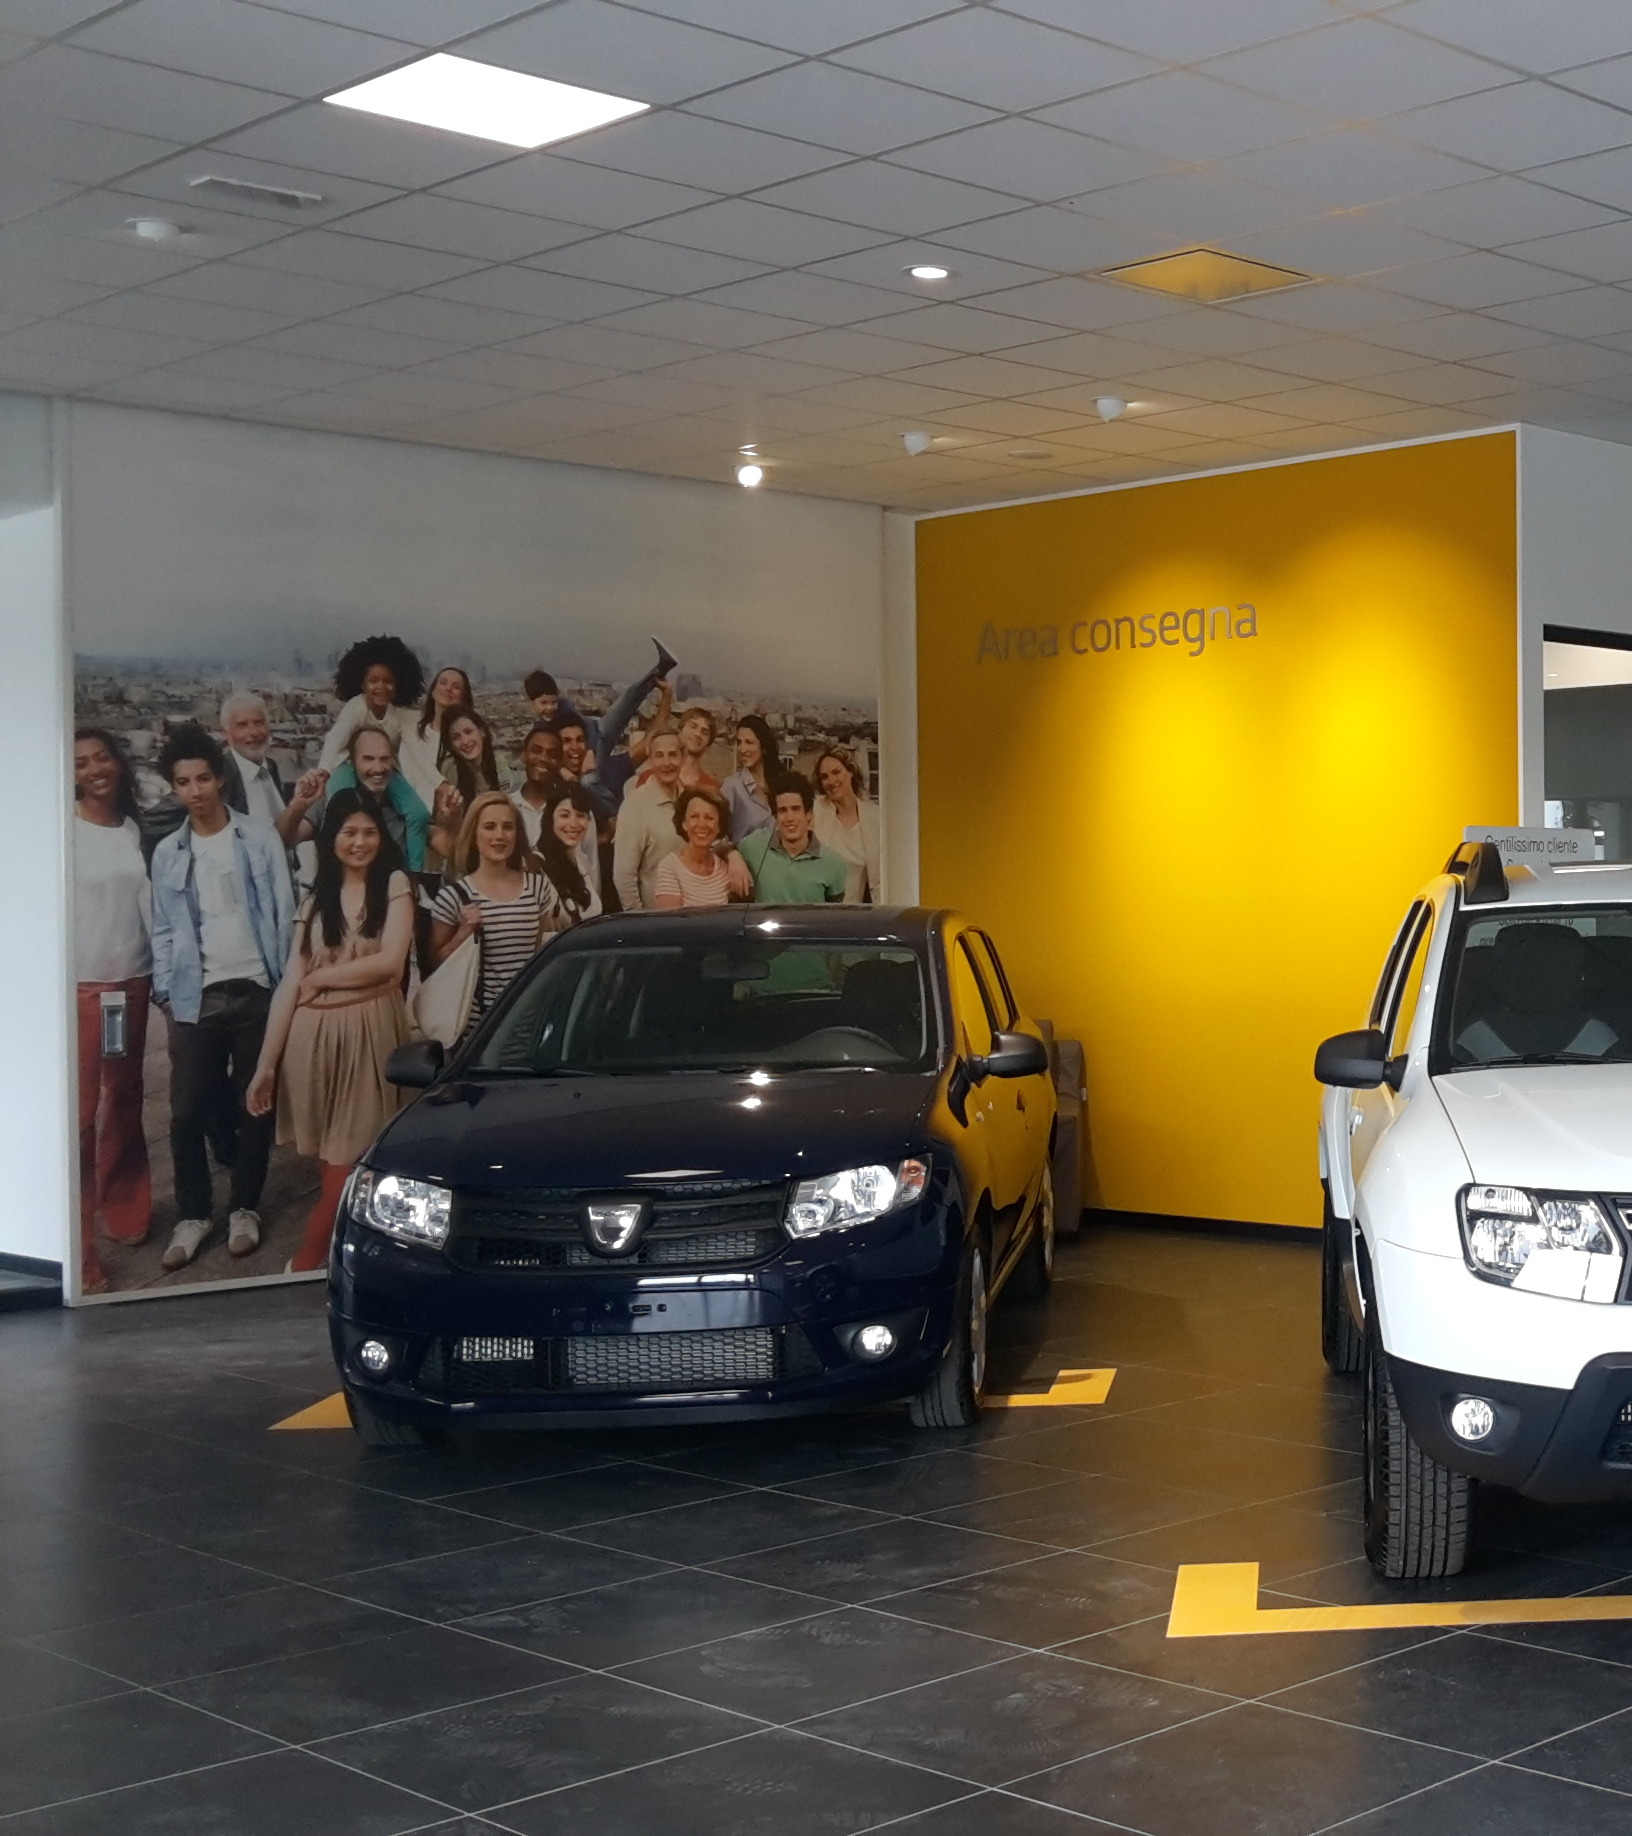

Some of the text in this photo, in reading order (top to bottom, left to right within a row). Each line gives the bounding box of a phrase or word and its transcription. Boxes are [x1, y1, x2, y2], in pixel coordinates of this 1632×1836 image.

[978, 602, 1258, 665] Area consegna
[1547, 837, 1578, 853] cliente
